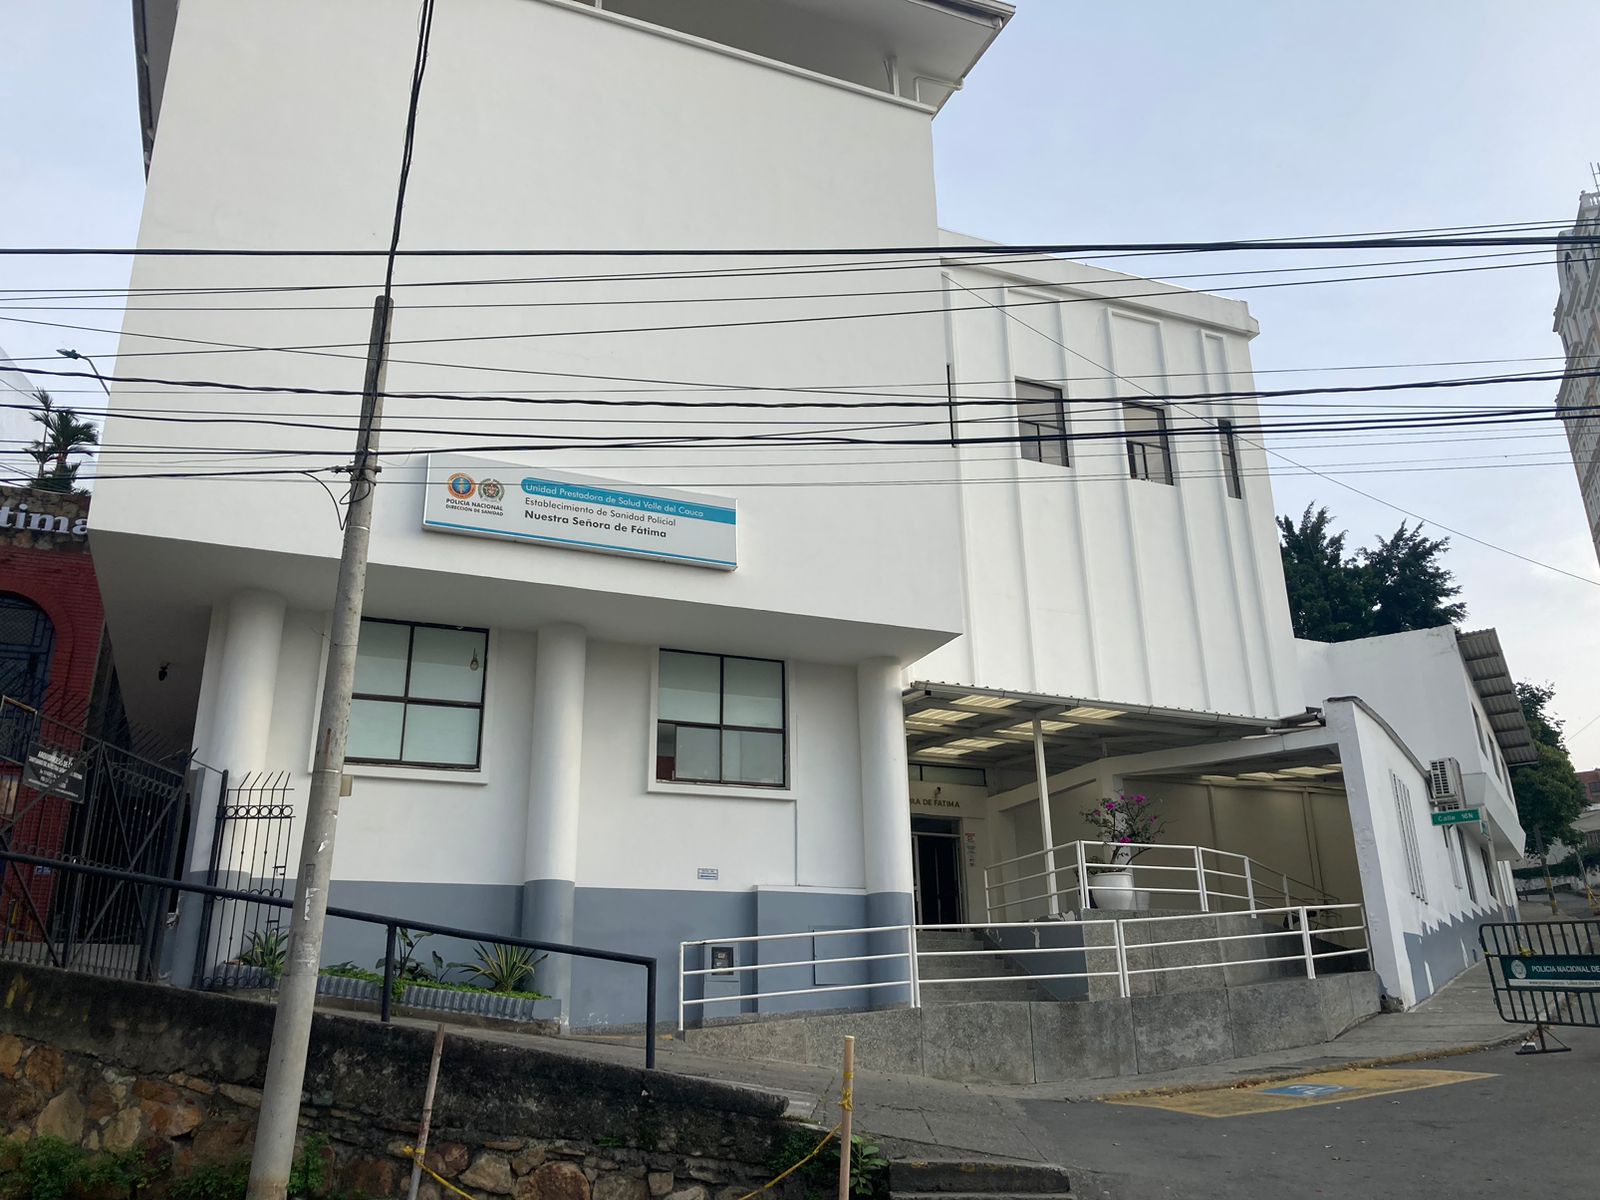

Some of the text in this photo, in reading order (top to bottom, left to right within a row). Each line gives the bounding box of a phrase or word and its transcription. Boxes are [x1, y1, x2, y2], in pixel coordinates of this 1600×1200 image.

[446, 498, 503, 511] POLICIA NACIONAL
[525, 483, 704, 517] Unidad Prestadora de Salud Valle del Cauca
[525, 497, 677, 527] Establecimiento de Sanidad Policial
[524, 510, 667, 538] Nuestra Señora de Fátima
[934, 800, 960, 808] FATIMA
[1531, 965, 1557, 973] POLICIA
[1557, 965, 1590, 973] NACIONAL
